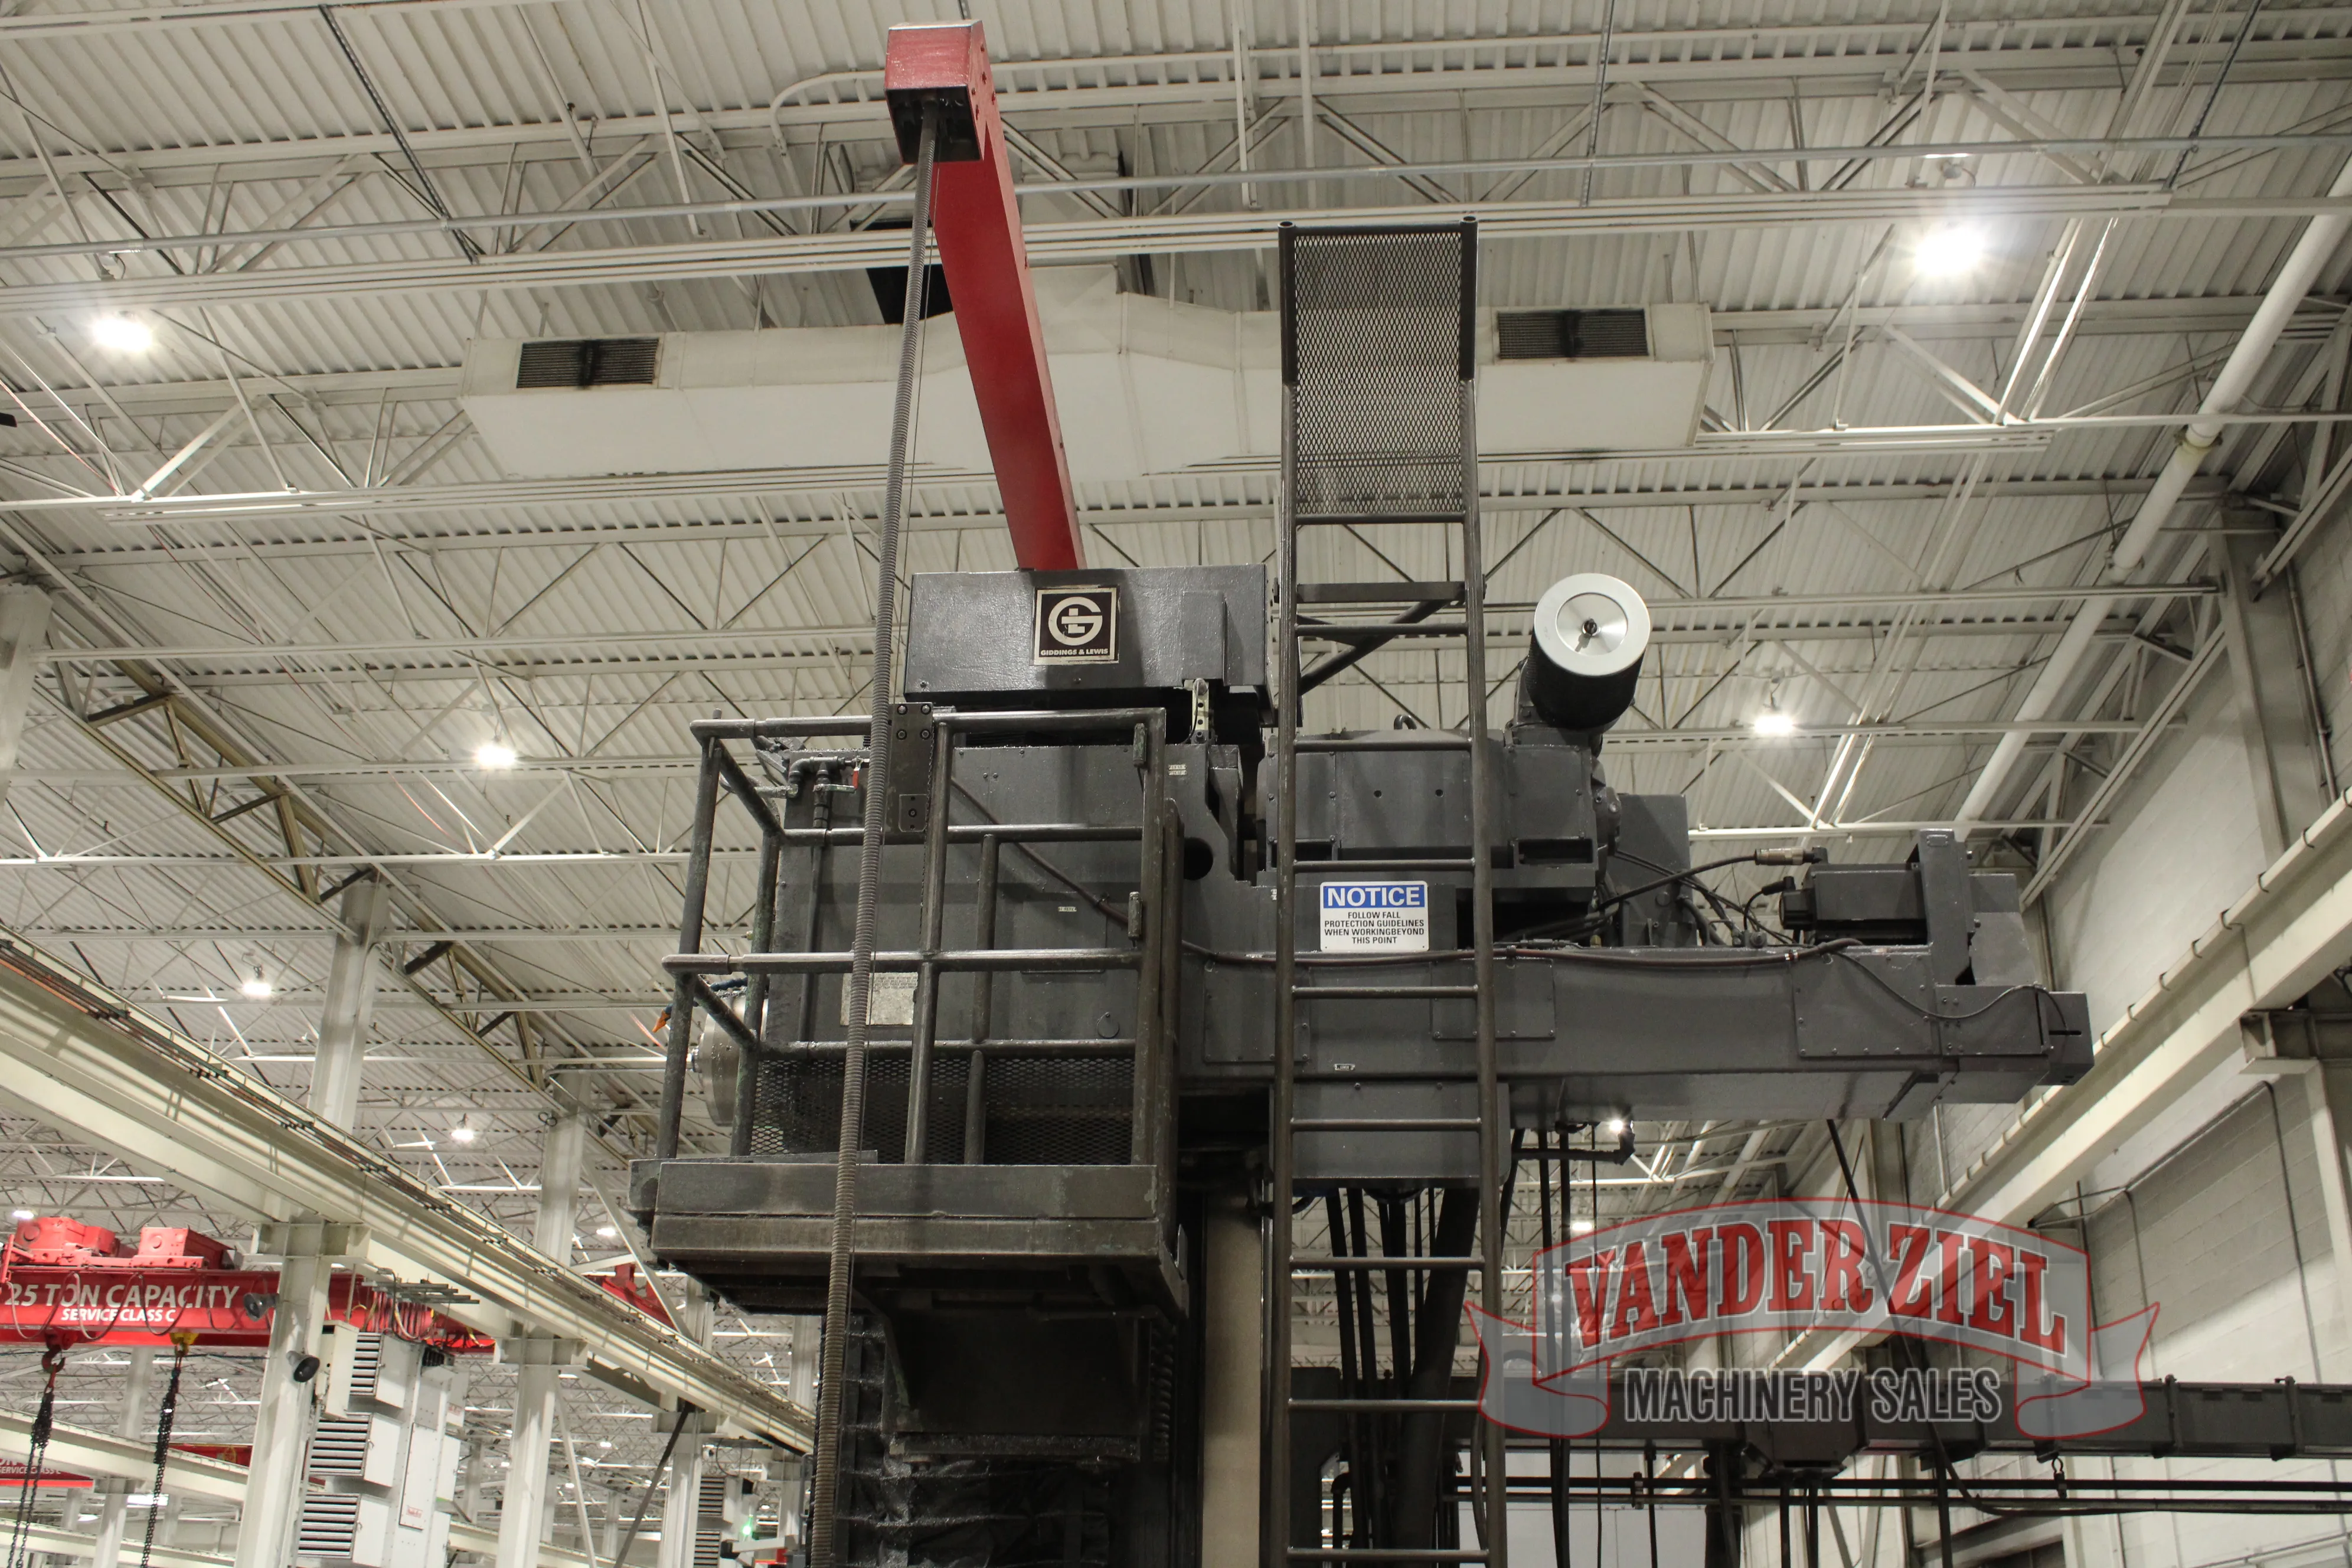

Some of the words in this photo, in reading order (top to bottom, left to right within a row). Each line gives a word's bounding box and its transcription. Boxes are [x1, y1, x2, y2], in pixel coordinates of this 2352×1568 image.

[1328, 887, 1420, 907] NOTICE
[1377, 919, 1424, 927] GUIDELINES
[5, 1283, 39, 1306] 25
[45, 1283, 101, 1307] TON
[106, 1284, 240, 1308] CAPACITY
[61, 1308, 119, 1322] SERVICE
[120, 1309, 163, 1322] CLASS
[165, 1309, 176, 1322] C
